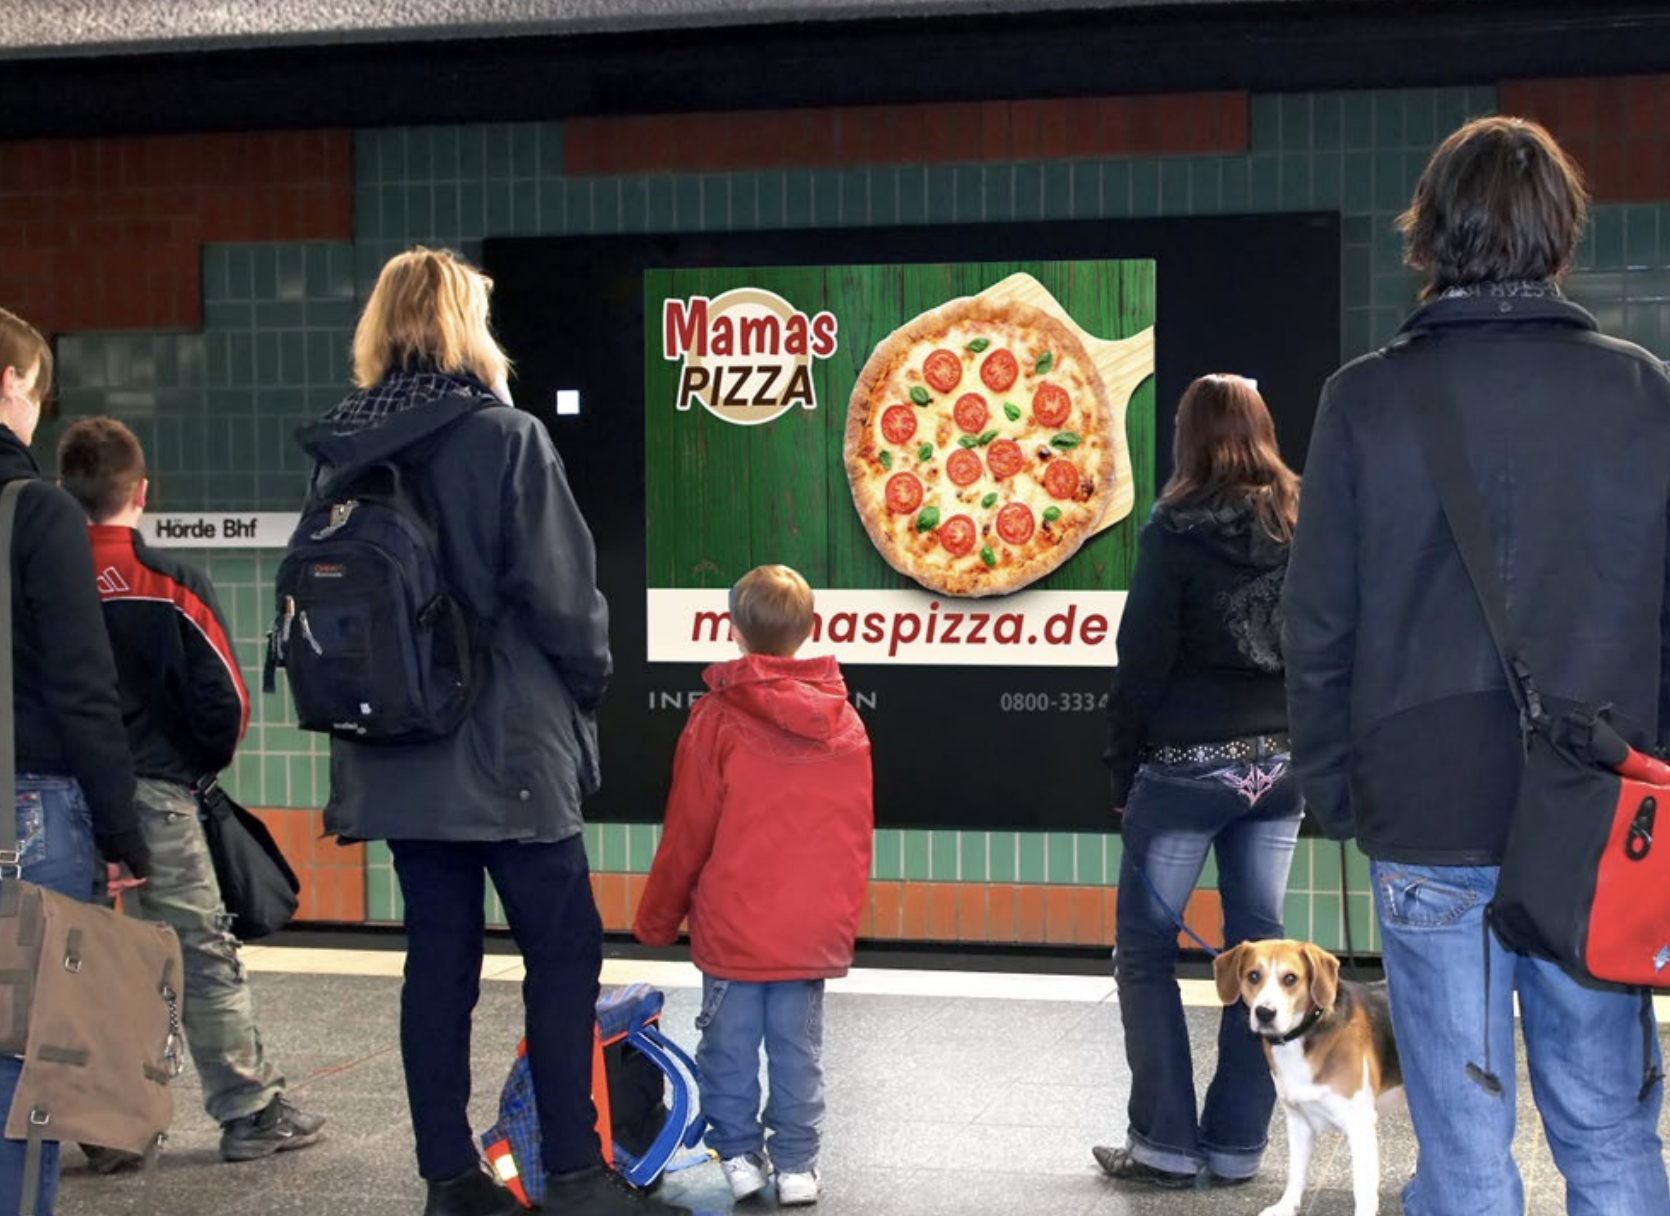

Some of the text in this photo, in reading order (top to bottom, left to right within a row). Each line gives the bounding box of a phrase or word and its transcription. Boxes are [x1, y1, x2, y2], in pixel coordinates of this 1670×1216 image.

[666, 299, 834, 357] Mamas
[679, 364, 814, 407] PIZZA
[156, 518, 258, 539] Hörde Bhf
[691, 601, 1108, 657] maspizza.de
